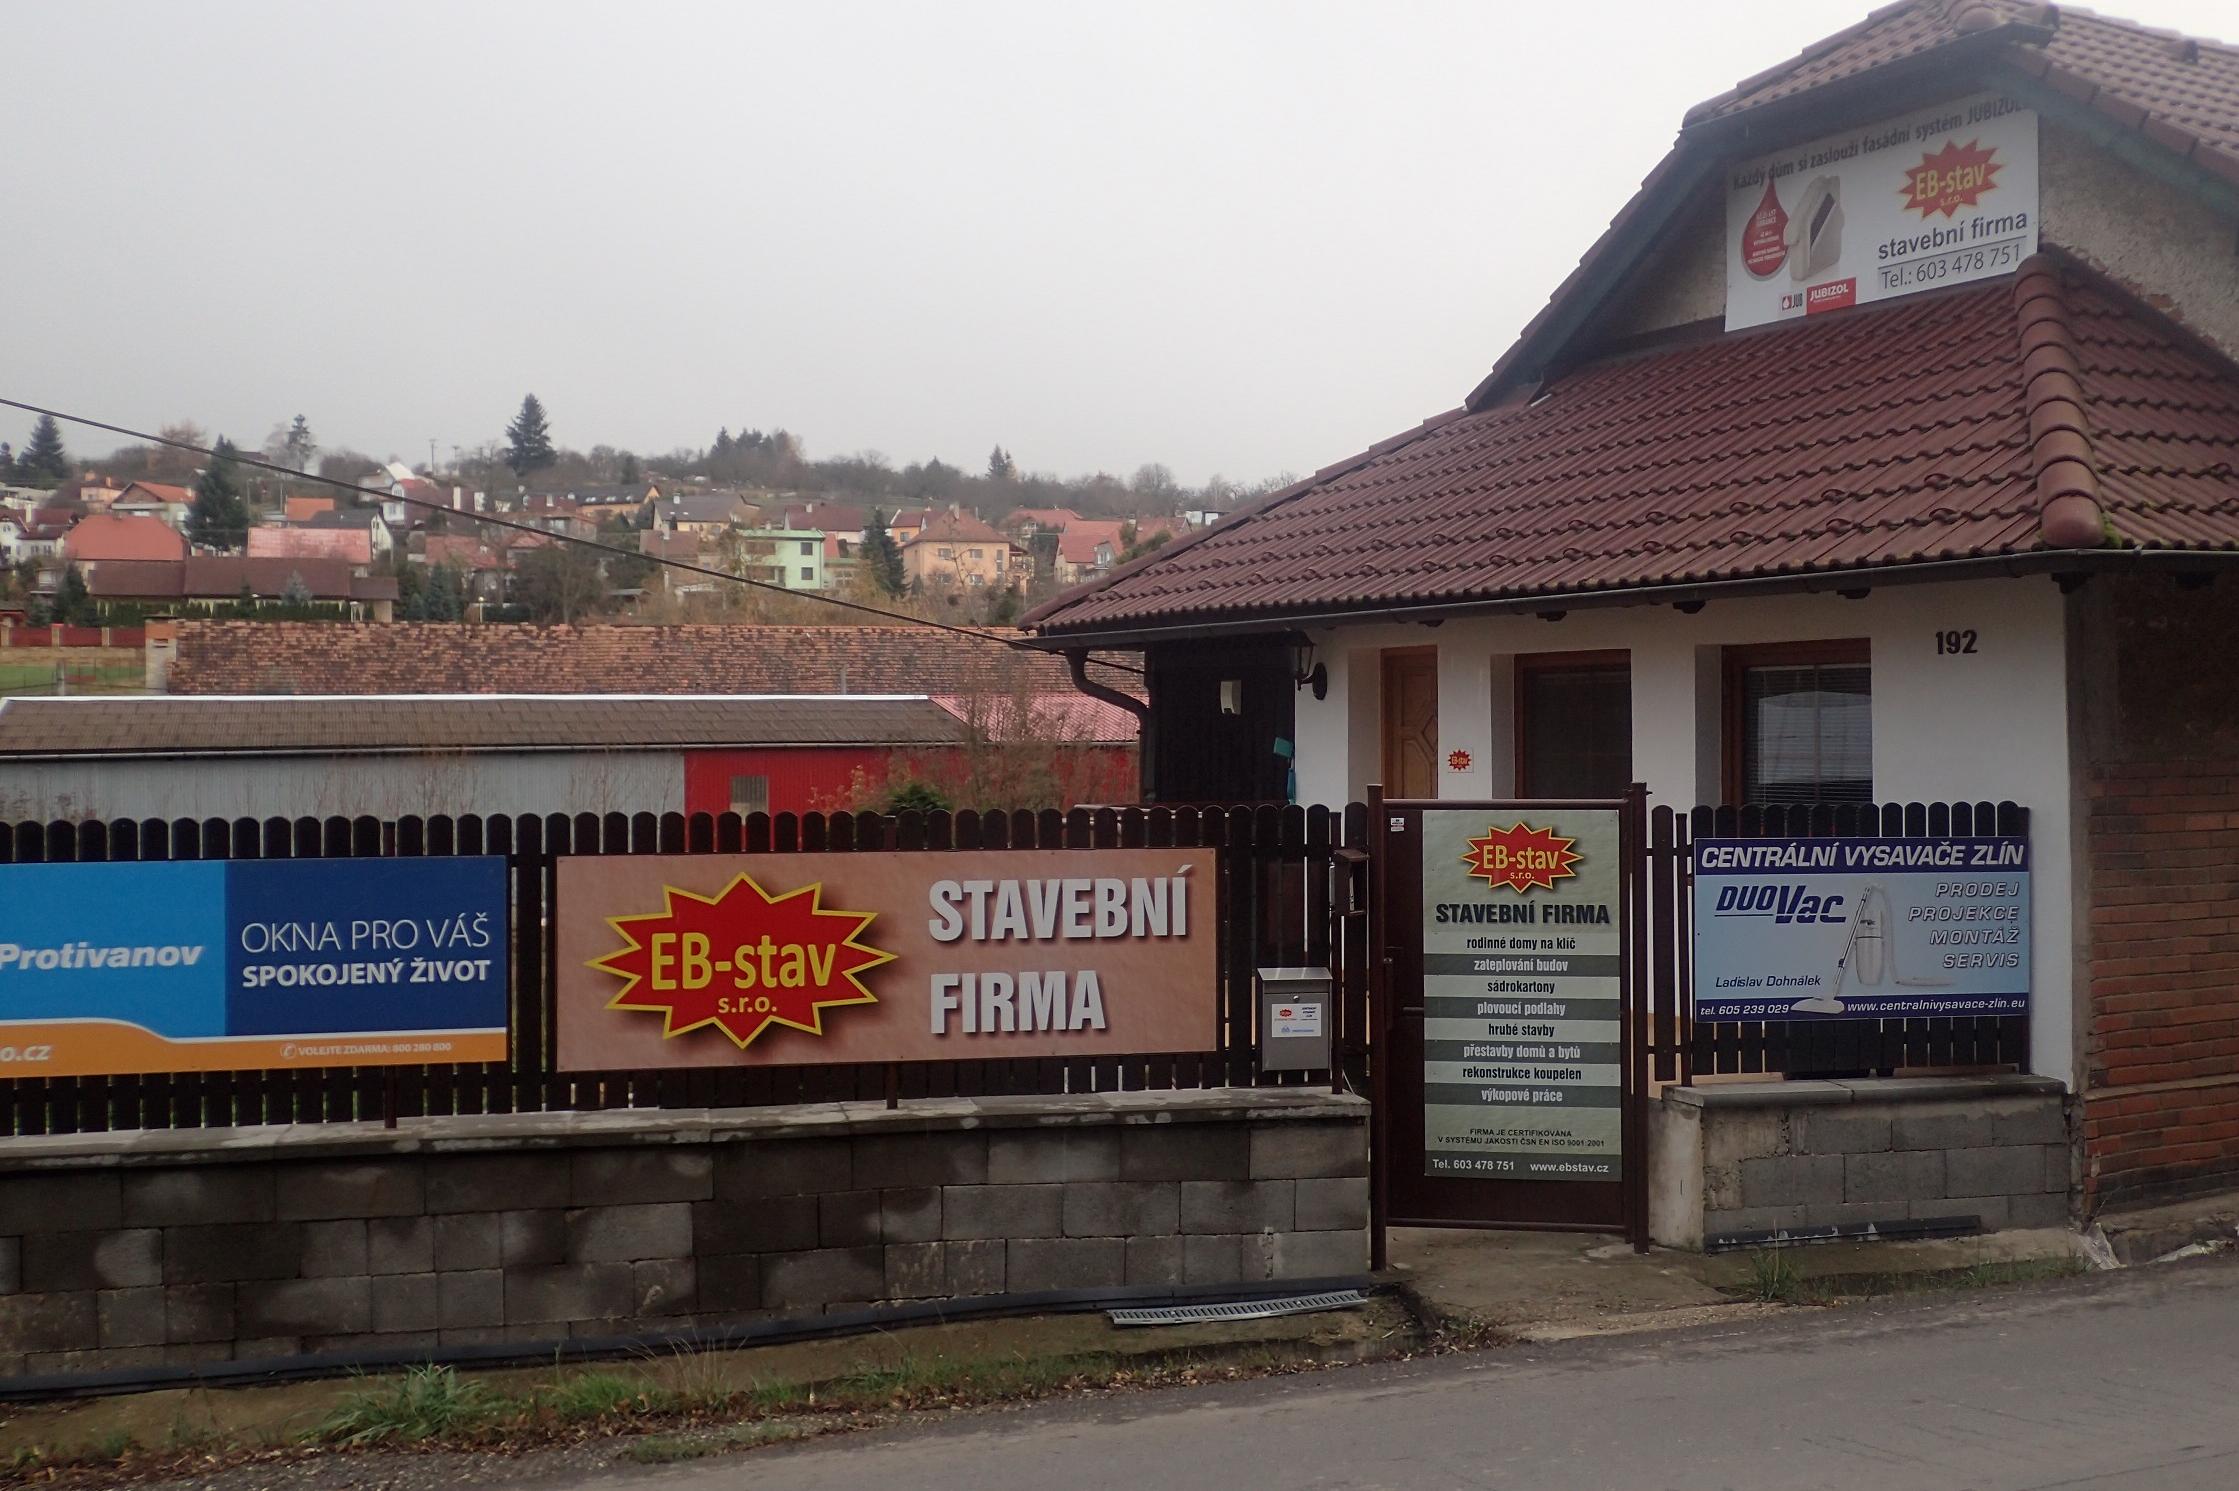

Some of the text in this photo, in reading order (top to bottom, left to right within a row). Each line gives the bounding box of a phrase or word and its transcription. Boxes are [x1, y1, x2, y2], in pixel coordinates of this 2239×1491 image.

[1798, 153, 1808, 172] si
[1915, 164, 1986, 201] EB-stav
[1878, 212, 2028, 259] stavební firma
[1881, 243, 2021, 289] Tel.: 603 478 751
[1809, 283, 1849, 302] JUBIZOL
[1935, 629, 1978, 655] 192
[1483, 845, 1559, 869] EB-stav
[1701, 841, 2024, 868] CENTRÁLNÍ VYSAVAČE ZLÍN
[1510, 872, 1535, 880] s.r.o.
[1935, 882, 2020, 898] PRODEJ
[928, 864, 1194, 943] STAVEBNÍ
[1436, 900, 1610, 924] STAVEBNÍ FIRMA
[1908, 906, 2020, 922] PROJEKCE
[241, 912, 491, 954] OKNA PRO VÁŠ
[1929, 926, 2020, 945] MONTÁŽ
[1466, 937, 1576, 950] rodinné domy na klíč
[0, 941, 203, 971] Protivanov
[650, 932, 837, 991] EB-stav
[1942, 953, 2020, 968] SERVIS
[242, 957, 492, 988] SPOKOJENÝ ŽIVOT
[1473, 958, 1569, 972] zateplování budov
[1487, 980, 1555, 994] sádrokartony
[1715, 974, 1821, 988] Ladislav Dohnálek
[718, 994, 777, 1014] s.r.o.
[929, 969, 1107, 1035] FIRMA
[1477, 1002, 1566, 1017] plovoucí podlahy
[1700, 1004, 1789, 1016] tel. 605 239 029
[1847, 998, 2026, 1012] www.centralnivysavace-zlin.eu
[1488, 1024, 1555, 1038] hrubé stavby
[1463, 1044, 1581, 1060] přestavby domů a bytů
[1462, 1067, 1582, 1081] rekonstrukce koupelen
[1481, 1087, 1563, 1103] výkopové práce
[1520, 1138, 1537, 1146] ČSN
[1433, 1159, 1609, 1173] Tel. 603 478 751 www.ebstav.cz
